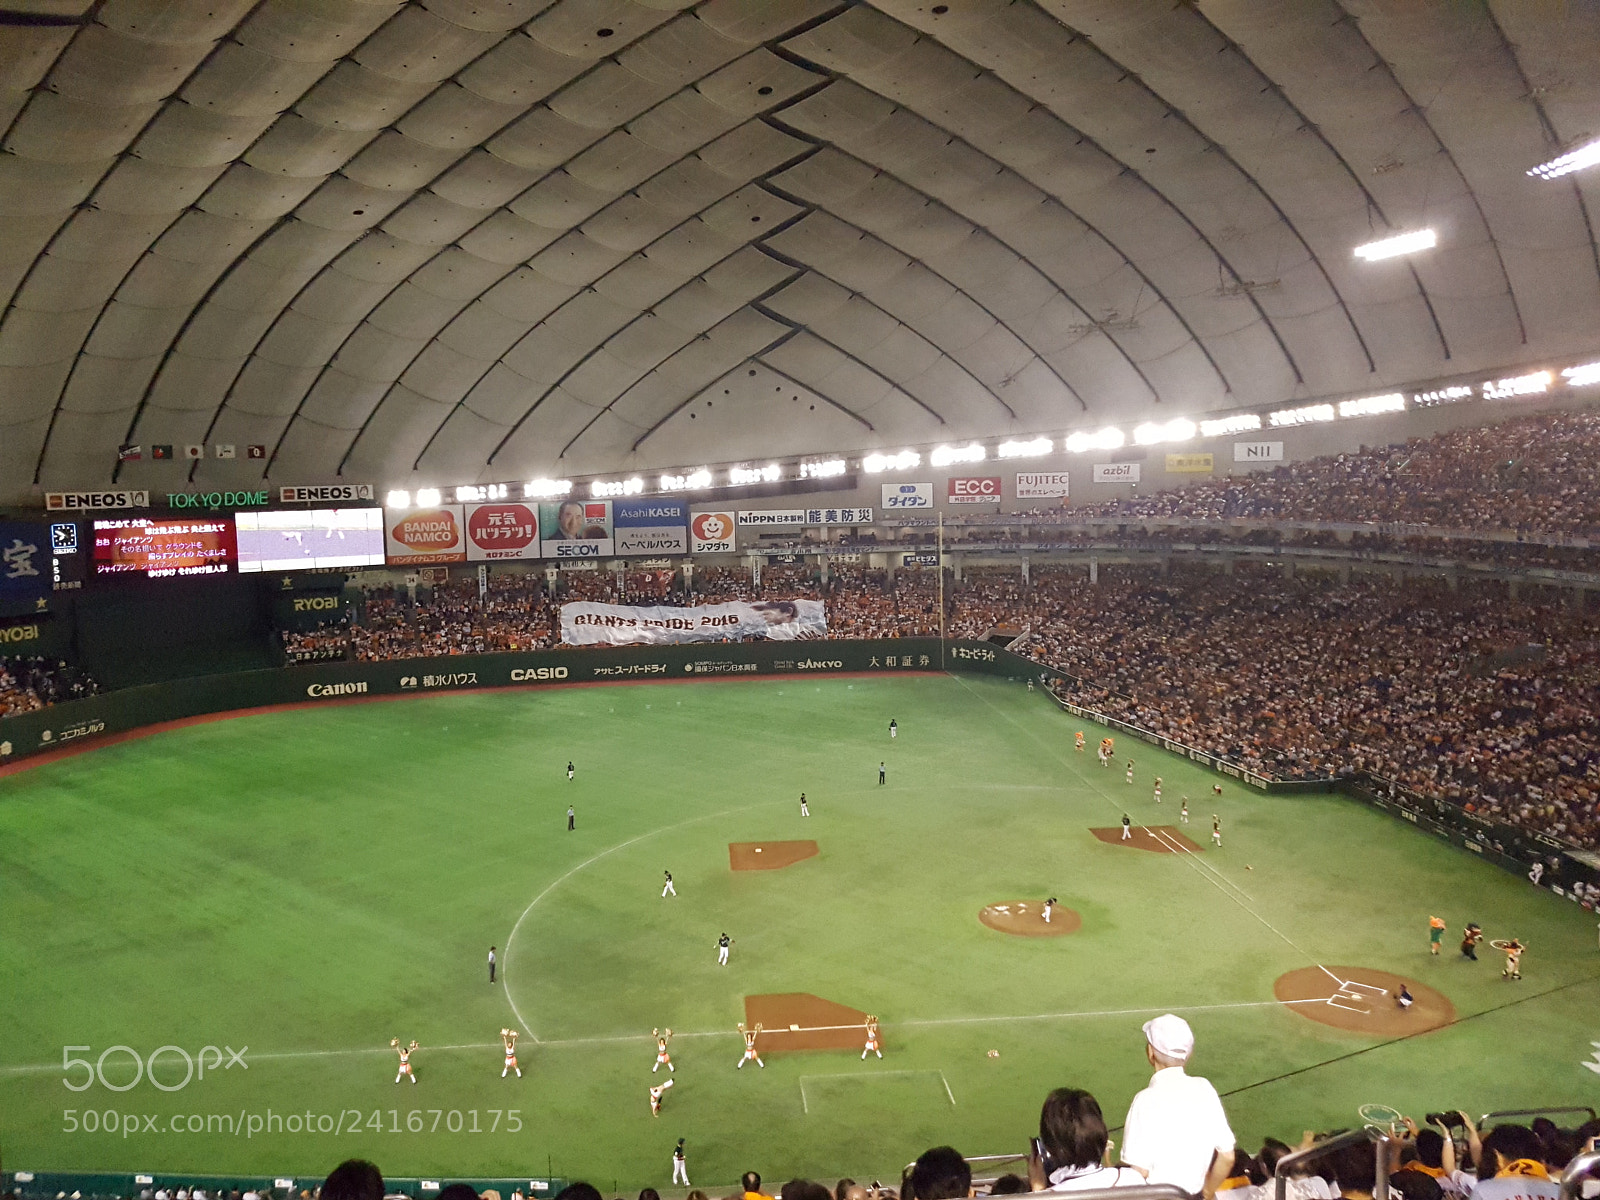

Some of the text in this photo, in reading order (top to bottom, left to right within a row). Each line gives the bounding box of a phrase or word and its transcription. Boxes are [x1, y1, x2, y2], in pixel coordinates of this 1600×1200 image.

[1248, 446, 1270, 457] NII
[1103, 465, 1130, 476] azbil
[954, 480, 994, 494] ECC
[1018, 475, 1067, 487] FUJITEC
[166, 491, 268, 508] TOKYO DOME
[296, 486, 352, 500] ENEOS
[65, 493, 126, 508] ENEOS
[888, 496, 926, 507] ダイダン
[488, 512, 517, 526] 元気
[620, 508, 680, 518] Asahi KASEI
[808, 509, 871, 522] 能美防災
[404, 521, 450, 533] BANDAI
[404, 531, 451, 543] NAMCO
[557, 544, 599, 556] SECOM
[621, 540, 681, 550] ヘーベルハウス
[698, 542, 730, 552] シマダヤ
[3, 539, 40, 579] 宝
[486, 551, 522, 559] オロナミンC
[53, 558, 59, 566] B
[54, 566, 60, 574] S
[294, 597, 339, 612] RYOBI
[574, 614, 637, 628] GIANTS
[0, 625, 39, 643] YOBI
[798, 658, 843, 670] SANKYO
[868, 654, 930, 668] 大和証券
[422, 672, 478, 688] 積水ハウス
[510, 666, 568, 681] CASIO
[307, 681, 368, 698] Canon
[60, 722, 106, 741] コニカミノルタ
